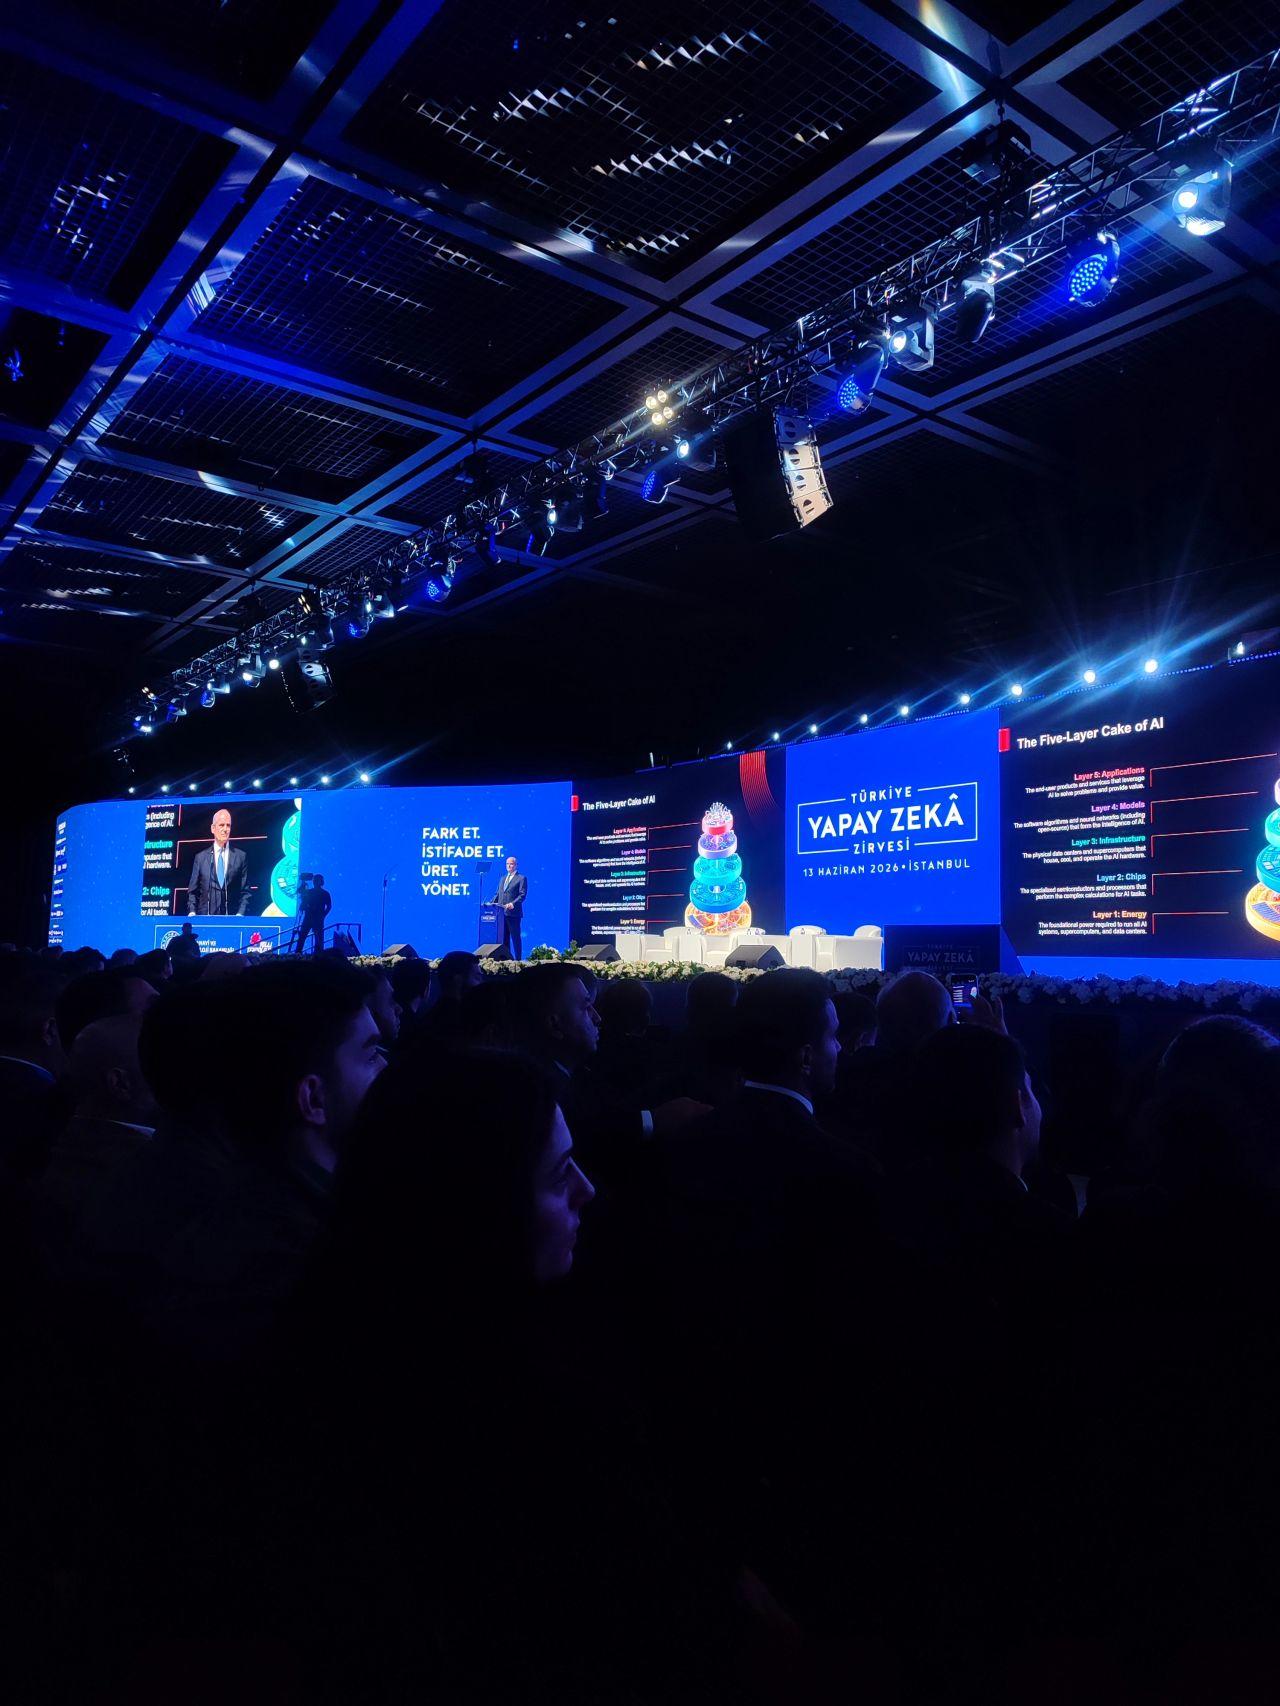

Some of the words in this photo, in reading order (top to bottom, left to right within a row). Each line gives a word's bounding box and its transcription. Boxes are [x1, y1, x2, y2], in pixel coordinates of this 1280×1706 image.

[1017, 738, 1037, 749] The
[1040, 729, 1099, 746] Five-Layer
[1102, 723, 1132, 736] Cake
[1135, 719, 1148, 731] of
[1150, 717, 1163, 730] AI
[1074, 773, 1093, 782] Layer
[1102, 767, 1145, 778] Applications
[1057, 783, 1078, 791] products
[1074, 788, 1097, 797] problems
[851, 786, 912, 804] TÜRKİYE
[596, 800, 626, 809] Five-Layer
[1092, 804, 1110, 813] Layer
[1120, 801, 1145, 810] Models
[808, 810, 882, 839] YAPAY
[890, 793, 964, 832] ZEKÂ
[1044, 818, 1068, 827] algorithms
[422, 827, 458, 839] FARK
[463, 827, 480, 838] ET.
[853, 836, 910, 854] ZİRVESİ
[1100, 835, 1145, 844] Infrastructure
[422, 843, 482, 858] İSTİFADE
[487, 846, 504, 857] ET.
[422, 862, 458, 876] ÜRET.
[803, 864, 813, 877] 13
[819, 864, 864, 876] HAZİRAN
[871, 864, 899, 873] 2026
[909, 859, 970, 871] İSTANBUL
[150, 886, 170, 897] Chips
[422, 880, 469, 895] YÖNET.
[1093, 911, 1112, 919] Layer
[1122, 910, 1147, 919] Energy
[908, 952, 941, 961] YAPAY
